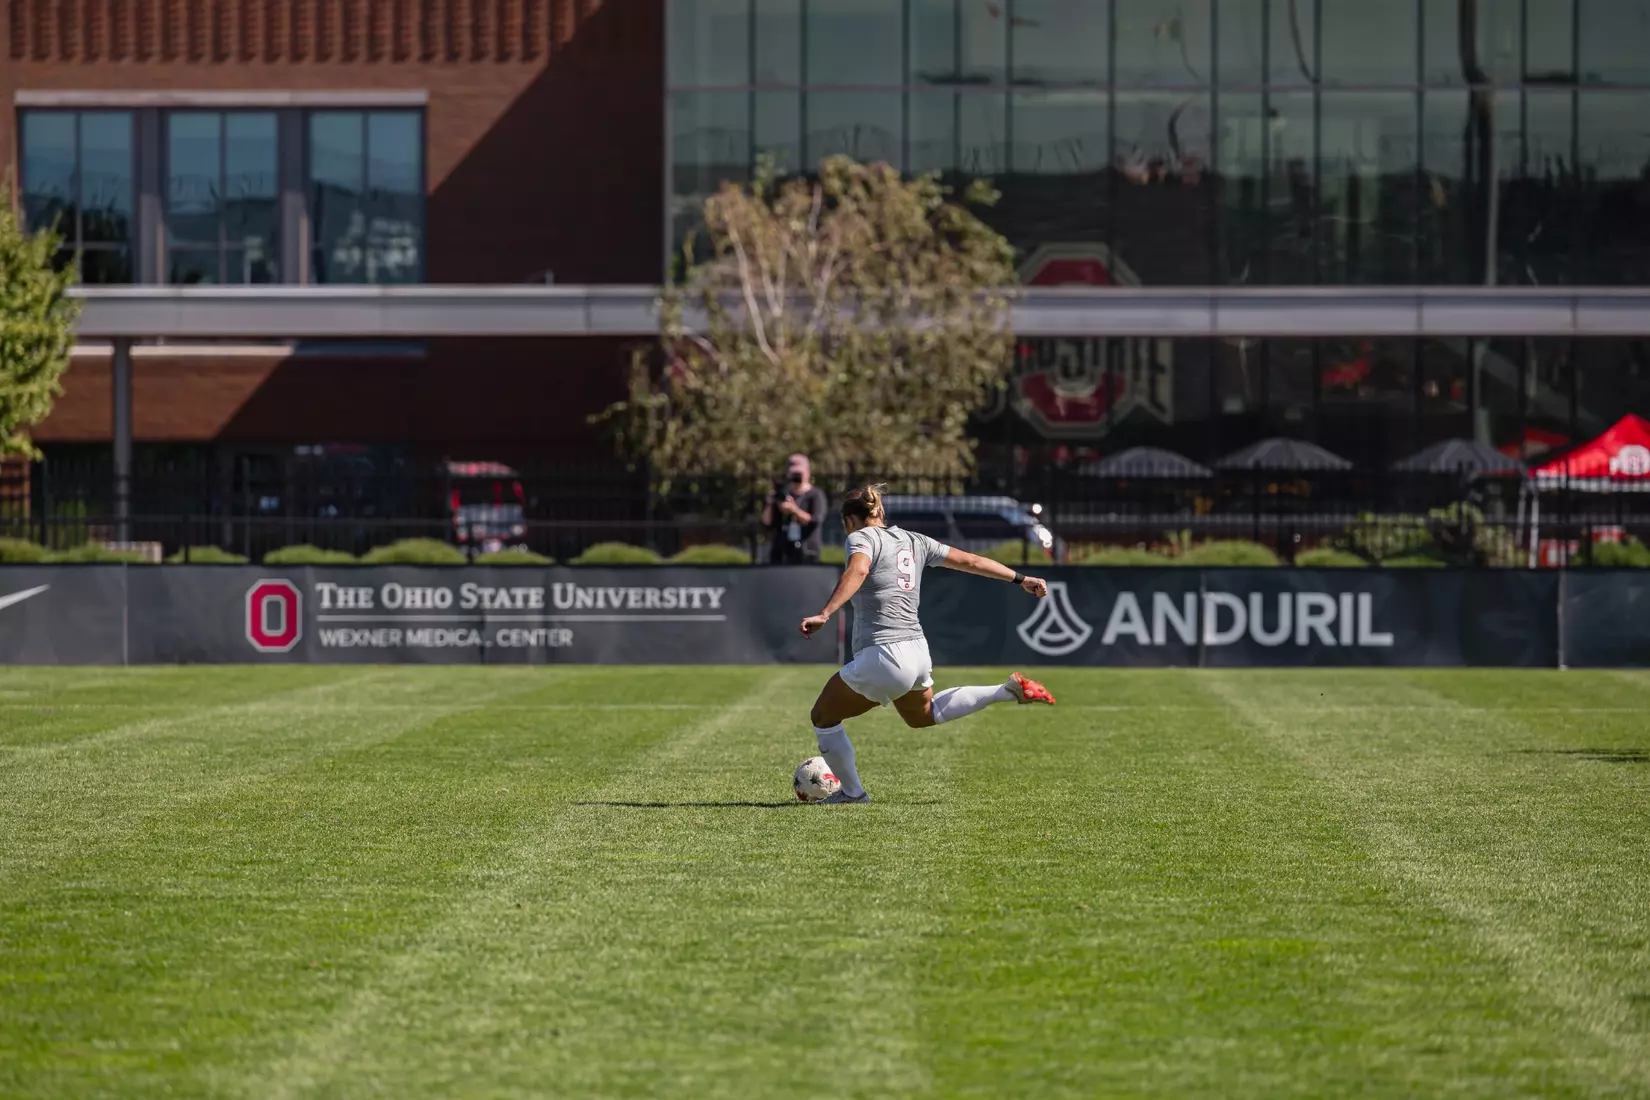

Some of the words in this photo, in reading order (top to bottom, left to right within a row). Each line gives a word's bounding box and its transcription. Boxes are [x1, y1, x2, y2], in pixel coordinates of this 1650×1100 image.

[897, 548, 916, 591] 9
[245, 578, 303, 653] O
[315, 582, 375, 609] THE
[381, 582, 454, 609] OHIO
[460, 582, 545, 609] STATE
[552, 582, 727, 609] UNIVERSITY
[319, 628, 403, 648] WEXNER
[405, 628, 494, 648] MEDICA
[496, 628, 574, 648] CENTER
[1101, 591, 1395, 647] ANDURIL
